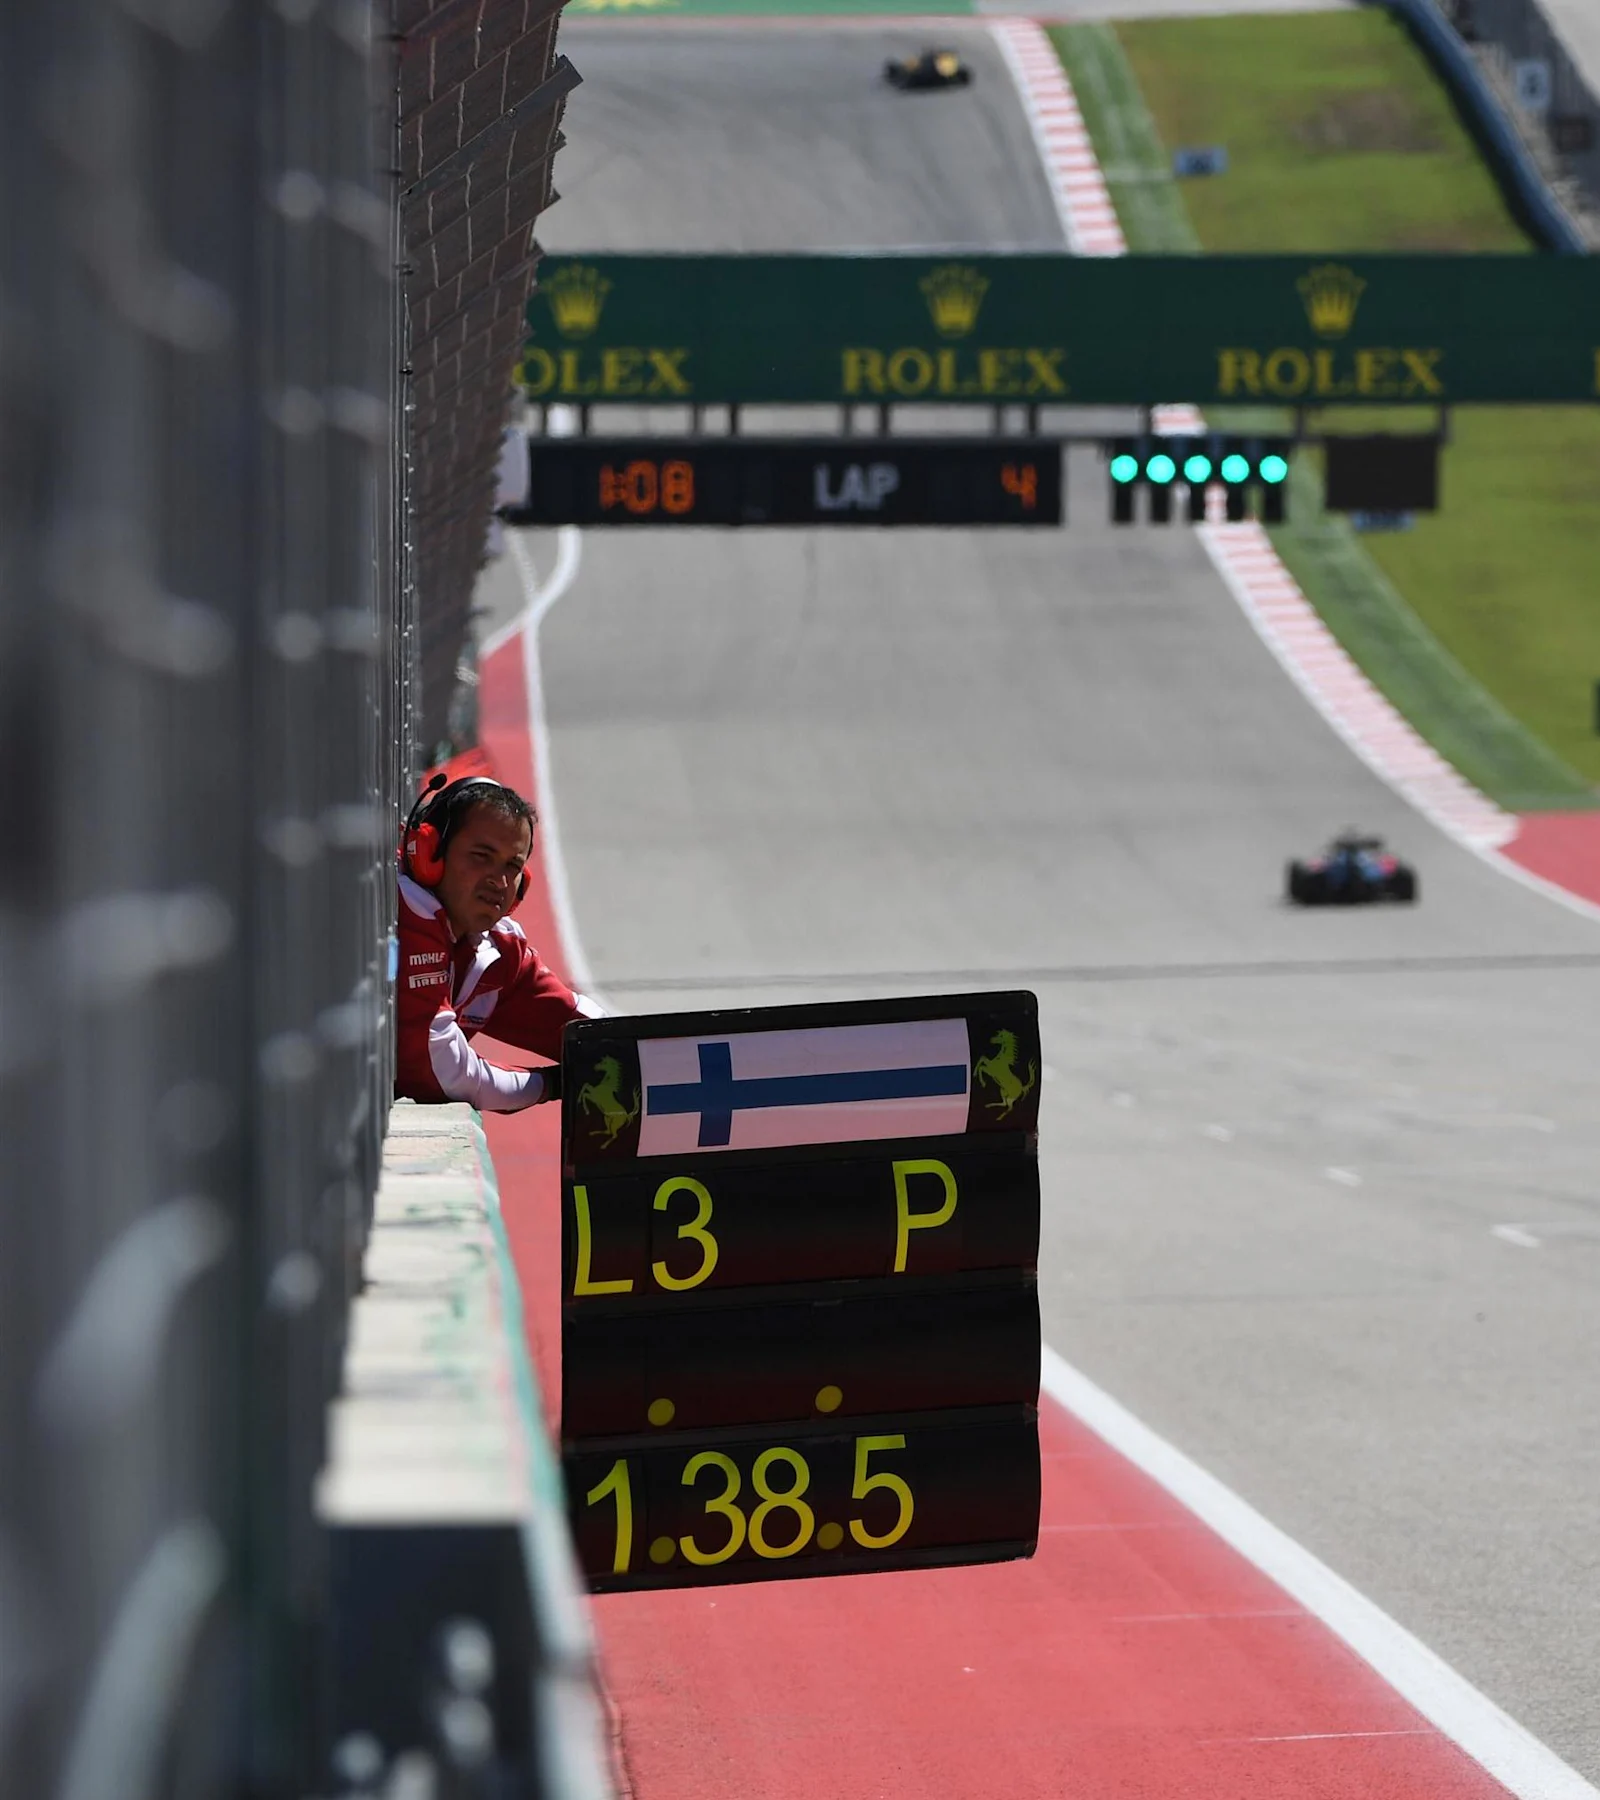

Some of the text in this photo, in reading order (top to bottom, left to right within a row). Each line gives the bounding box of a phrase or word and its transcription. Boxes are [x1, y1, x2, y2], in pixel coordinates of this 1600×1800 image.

[512, 347, 692, 396] OLEX
[842, 347, 1067, 396] ROLEX
[1217, 347, 1443, 396] ROLEX
[814, 463, 899, 510] LAP
[1002, 463, 1038, 509] 4
[892, 1159, 958, 1273] P
